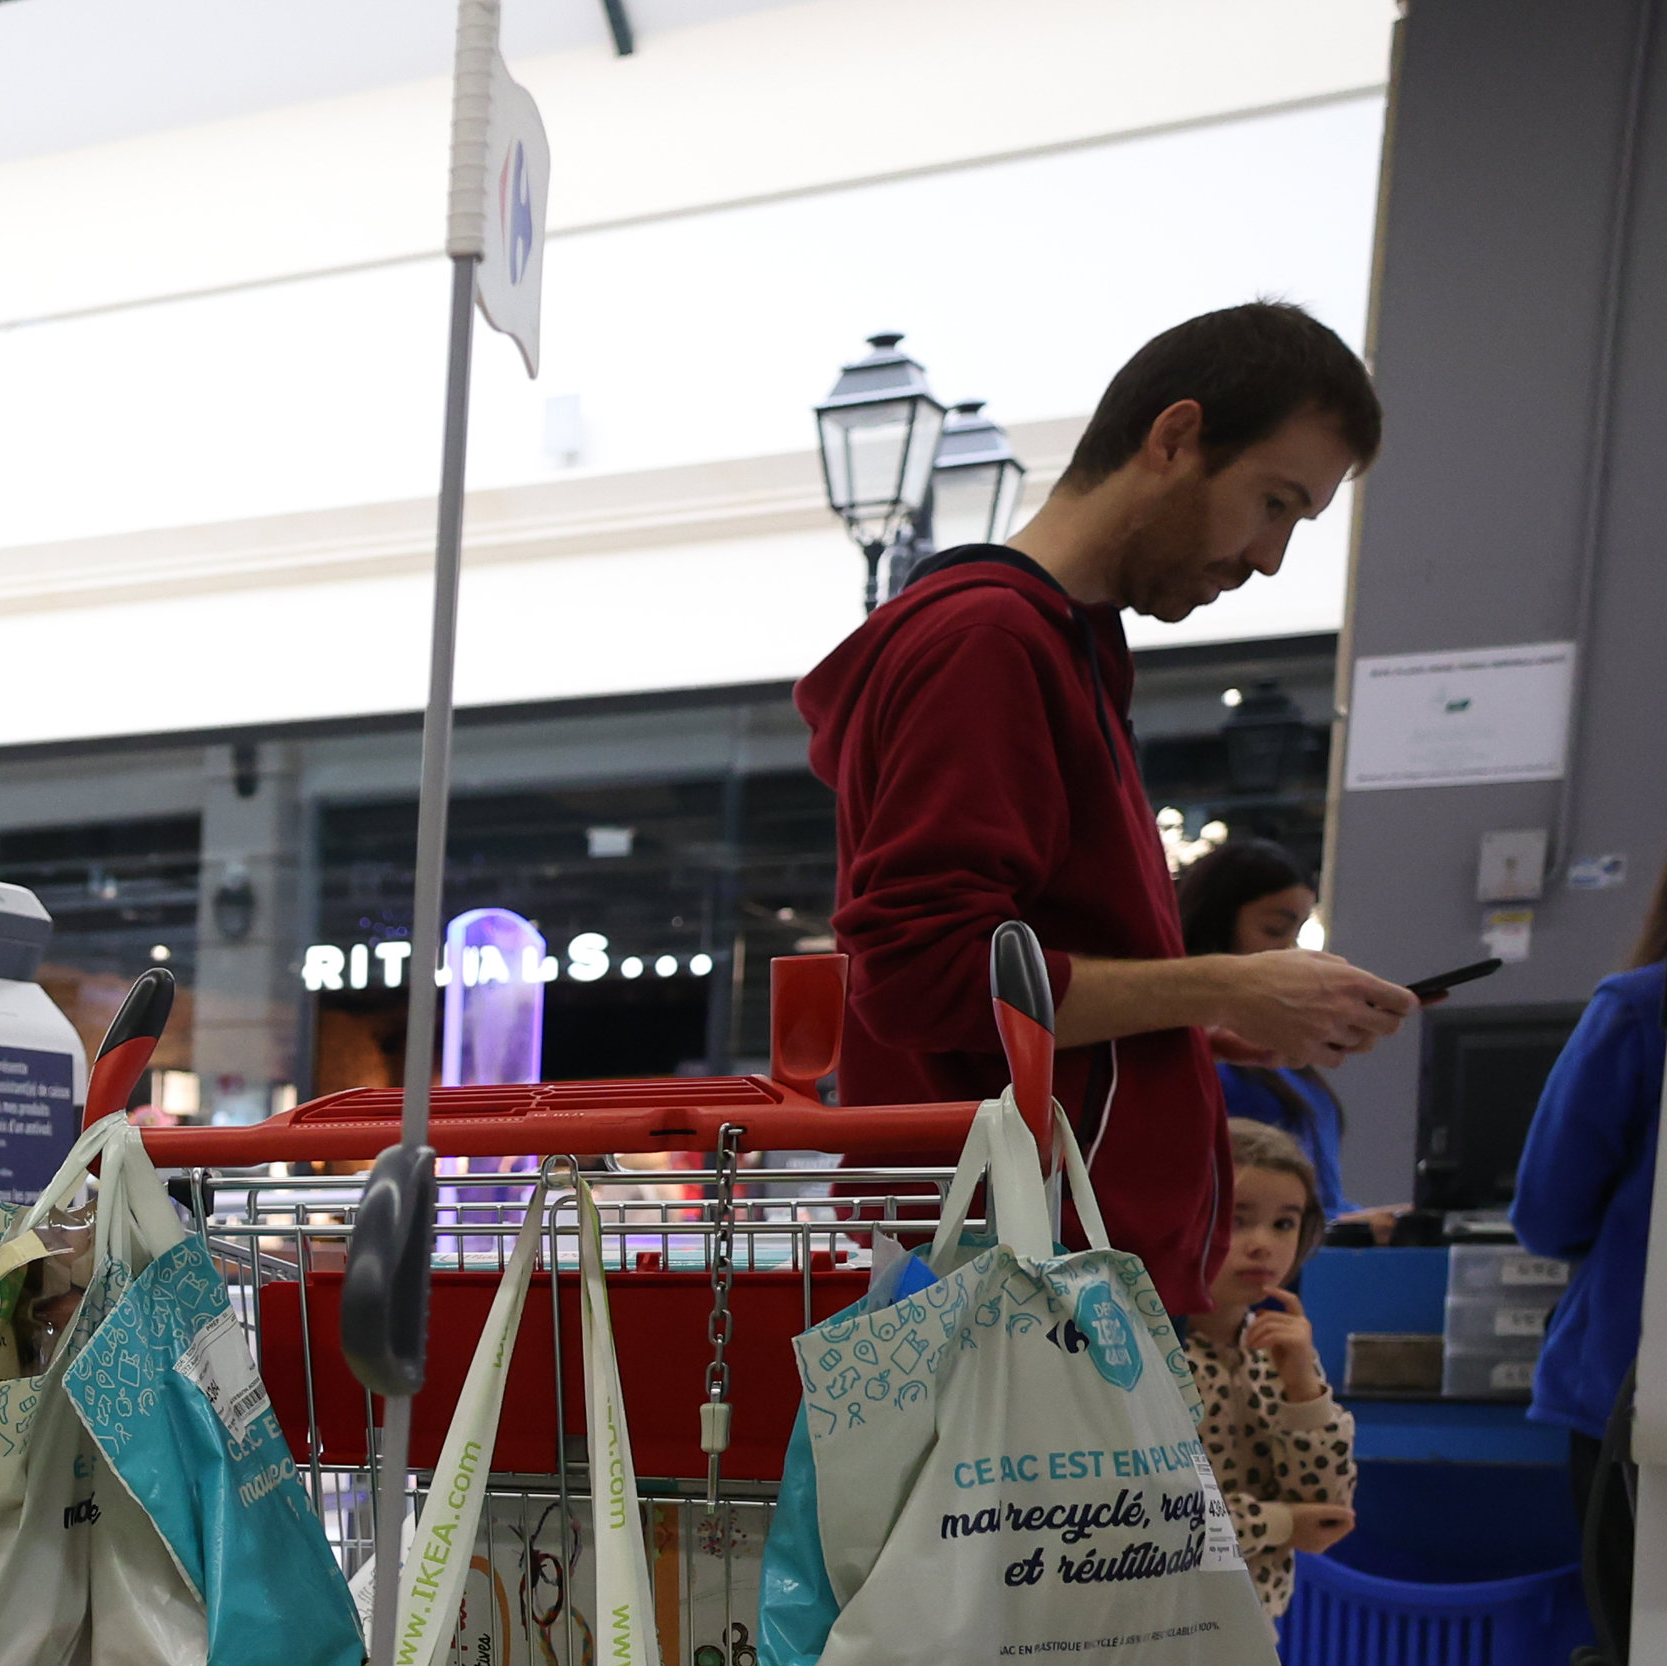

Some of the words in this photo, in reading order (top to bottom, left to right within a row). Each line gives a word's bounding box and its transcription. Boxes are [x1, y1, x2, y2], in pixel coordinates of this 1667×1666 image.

[954, 1458, 995, 1489] CE
[1001, 1454, 1039, 1483] AC
[1049, 1451, 1104, 1480] EST
[1113, 1449, 1149, 1478] EN
[1005, 1489, 1150, 1544] recyclé,
[1160, 1491, 1205, 1532] recy
[1004, 1548, 1044, 1587] et
[1057, 1531, 1205, 1585] réutilisabl
[999, 1645, 1016, 1656] AC
